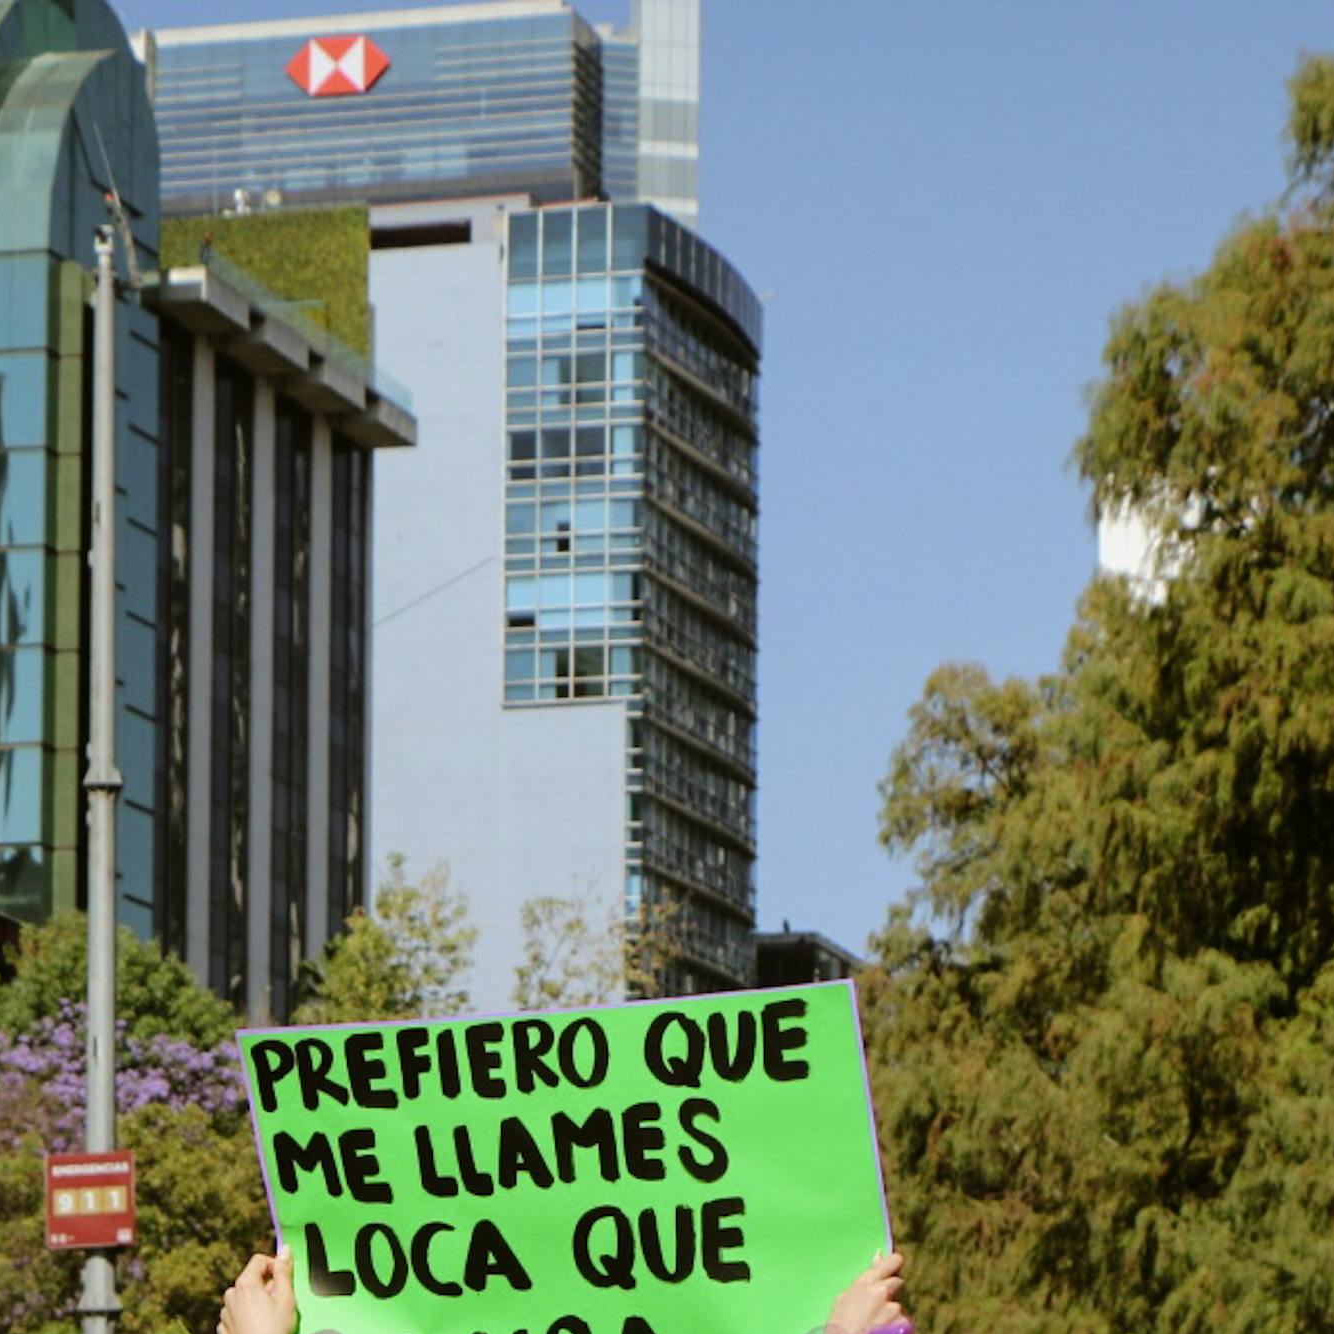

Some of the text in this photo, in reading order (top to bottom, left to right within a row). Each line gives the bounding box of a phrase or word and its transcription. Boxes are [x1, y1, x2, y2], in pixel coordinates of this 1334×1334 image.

[250, 998, 810, 1113] PREFIERO QUE
[58, 1190, 120, 1213] 911
[272, 1097, 730, 1204] ME LLAMES
[304, 1197, 751, 1300] LOCA QUE
